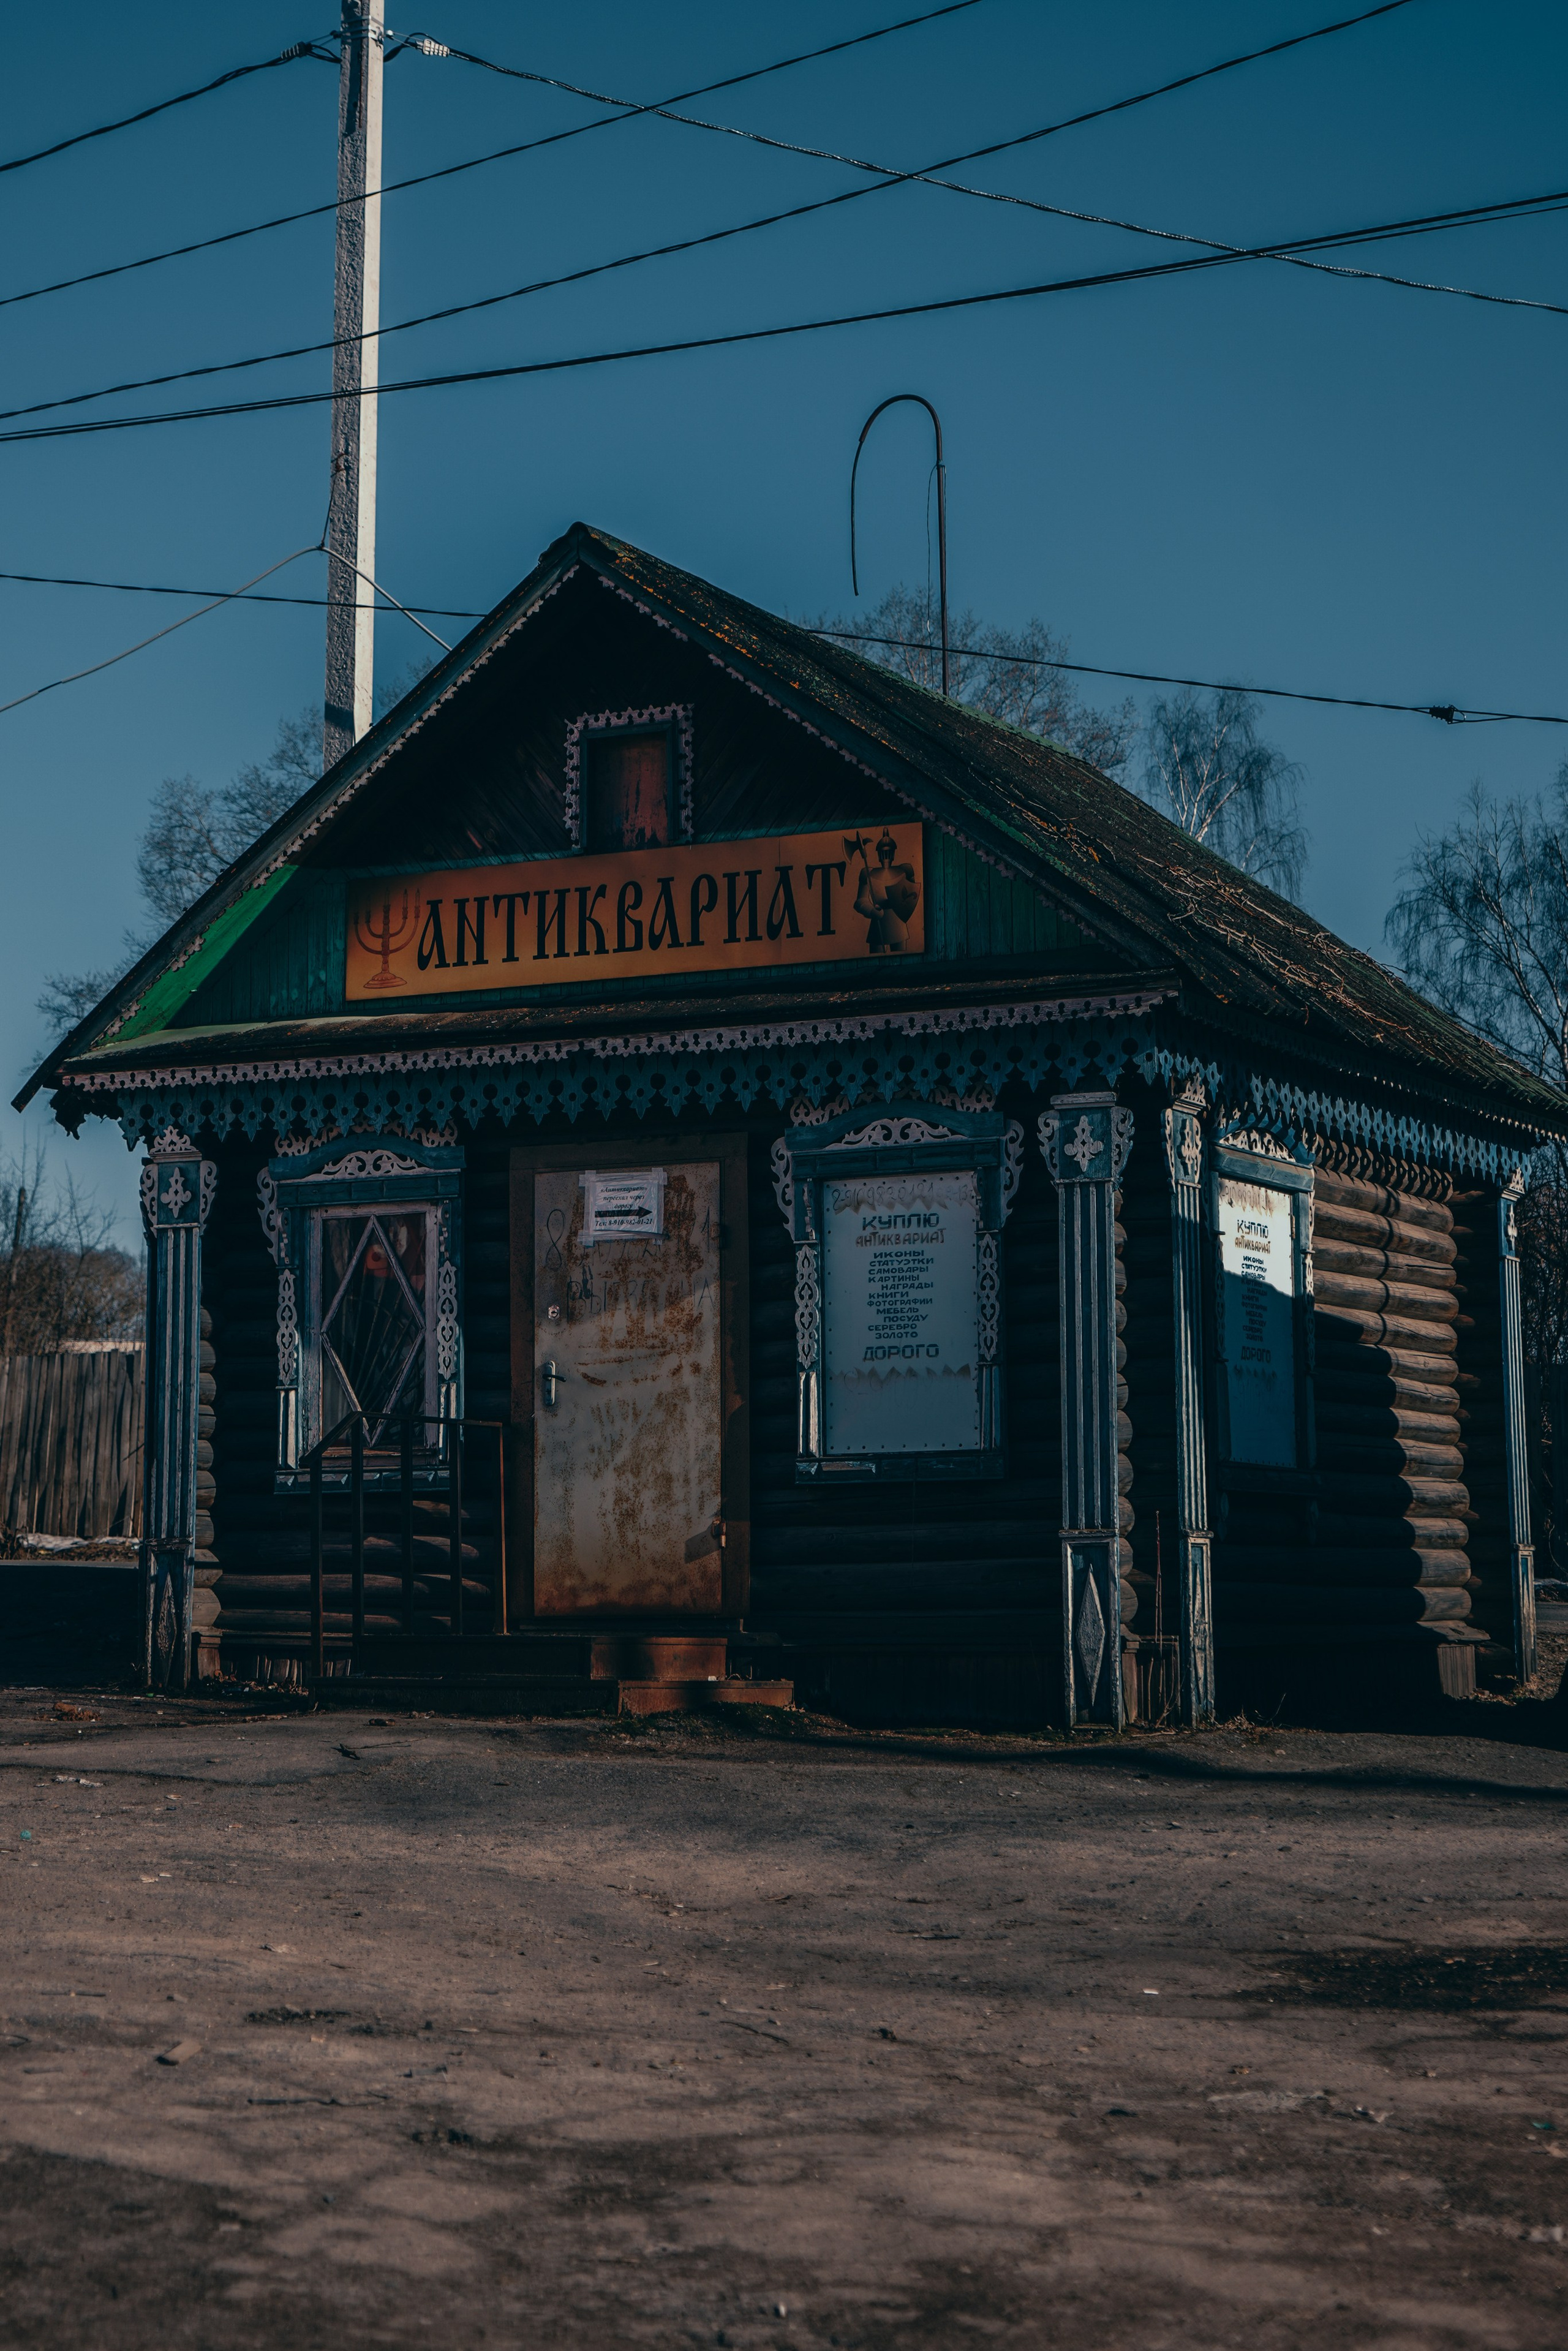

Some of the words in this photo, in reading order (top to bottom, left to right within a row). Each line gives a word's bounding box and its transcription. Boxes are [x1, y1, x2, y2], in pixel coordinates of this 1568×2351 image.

[417, 860, 846, 972] АНТИКВАРИАТ
[862, 1213, 939, 1231] КУПЛЮ
[1237, 1220, 1268, 1239] КУПЛЮ
[856, 1228, 946, 1247] АНТИКВАРИАТ
[1235, 1235, 1271, 1255] АНТИКВАРИАТ
[870, 1258, 934, 1266] СТАТУЭТКИ
[1243, 1256, 1264, 1265] ИКОНЫ
[868, 1266, 929, 1275] САМОВАРЫ
[881, 1282, 933, 1291] НАГРАДЫ
[867, 1298, 933, 1307] ФОТОГРАФИИ
[862, 1343, 940, 1362] ДОРОГО
[1242, 1346, 1271, 1364] ДОРОГО
